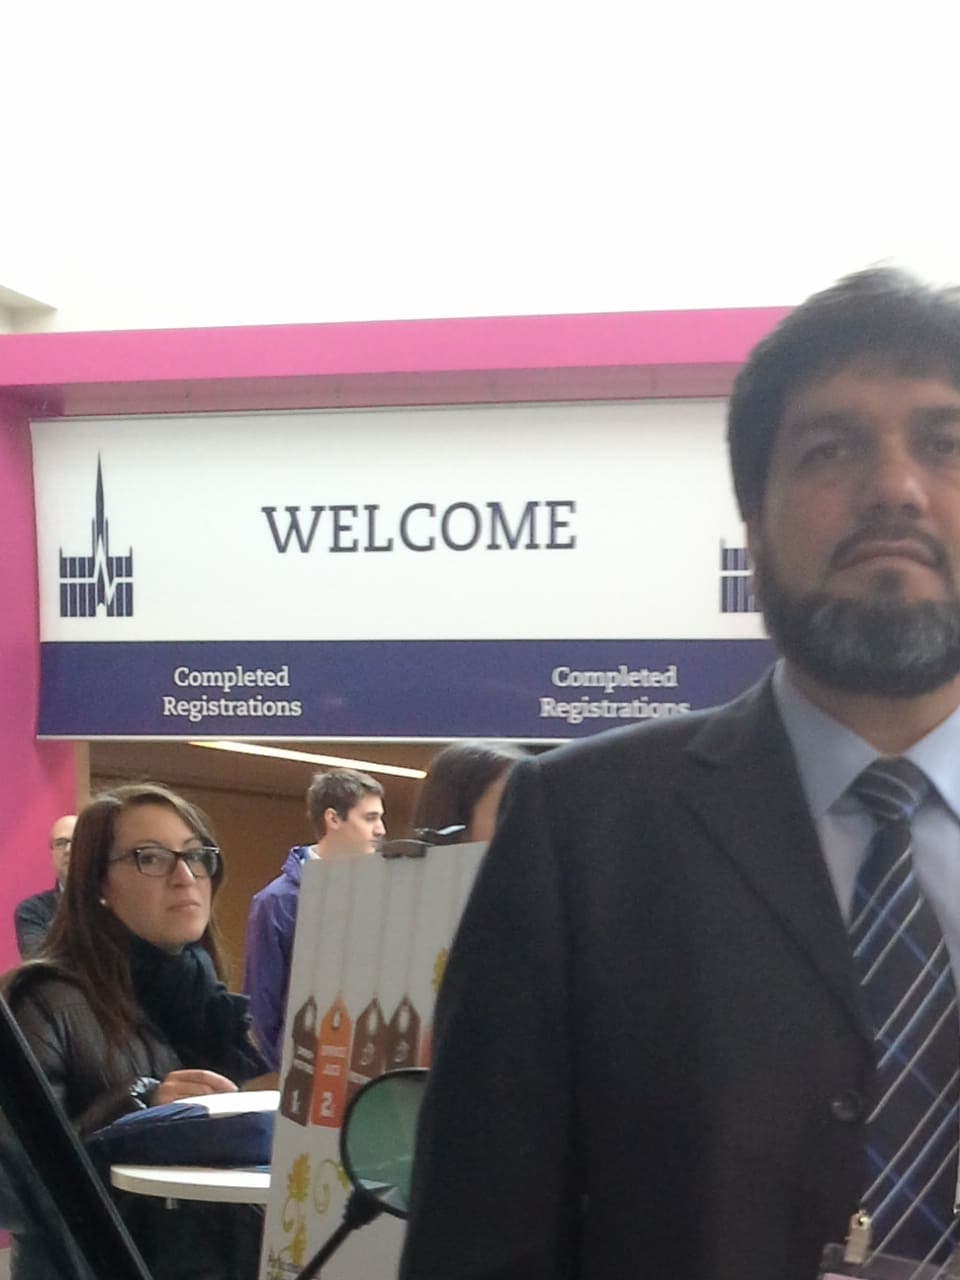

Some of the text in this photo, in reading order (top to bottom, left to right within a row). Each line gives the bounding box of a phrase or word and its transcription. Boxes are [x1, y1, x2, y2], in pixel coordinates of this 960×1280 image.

[261, 501, 576, 553] WELCOME
[174, 666, 290, 692] Completed
[552, 665, 678, 693] Completed
[162, 695, 302, 721] Registrations
[539, 696, 691, 723] Registrations
[320, 1092, 335, 1118] 2
